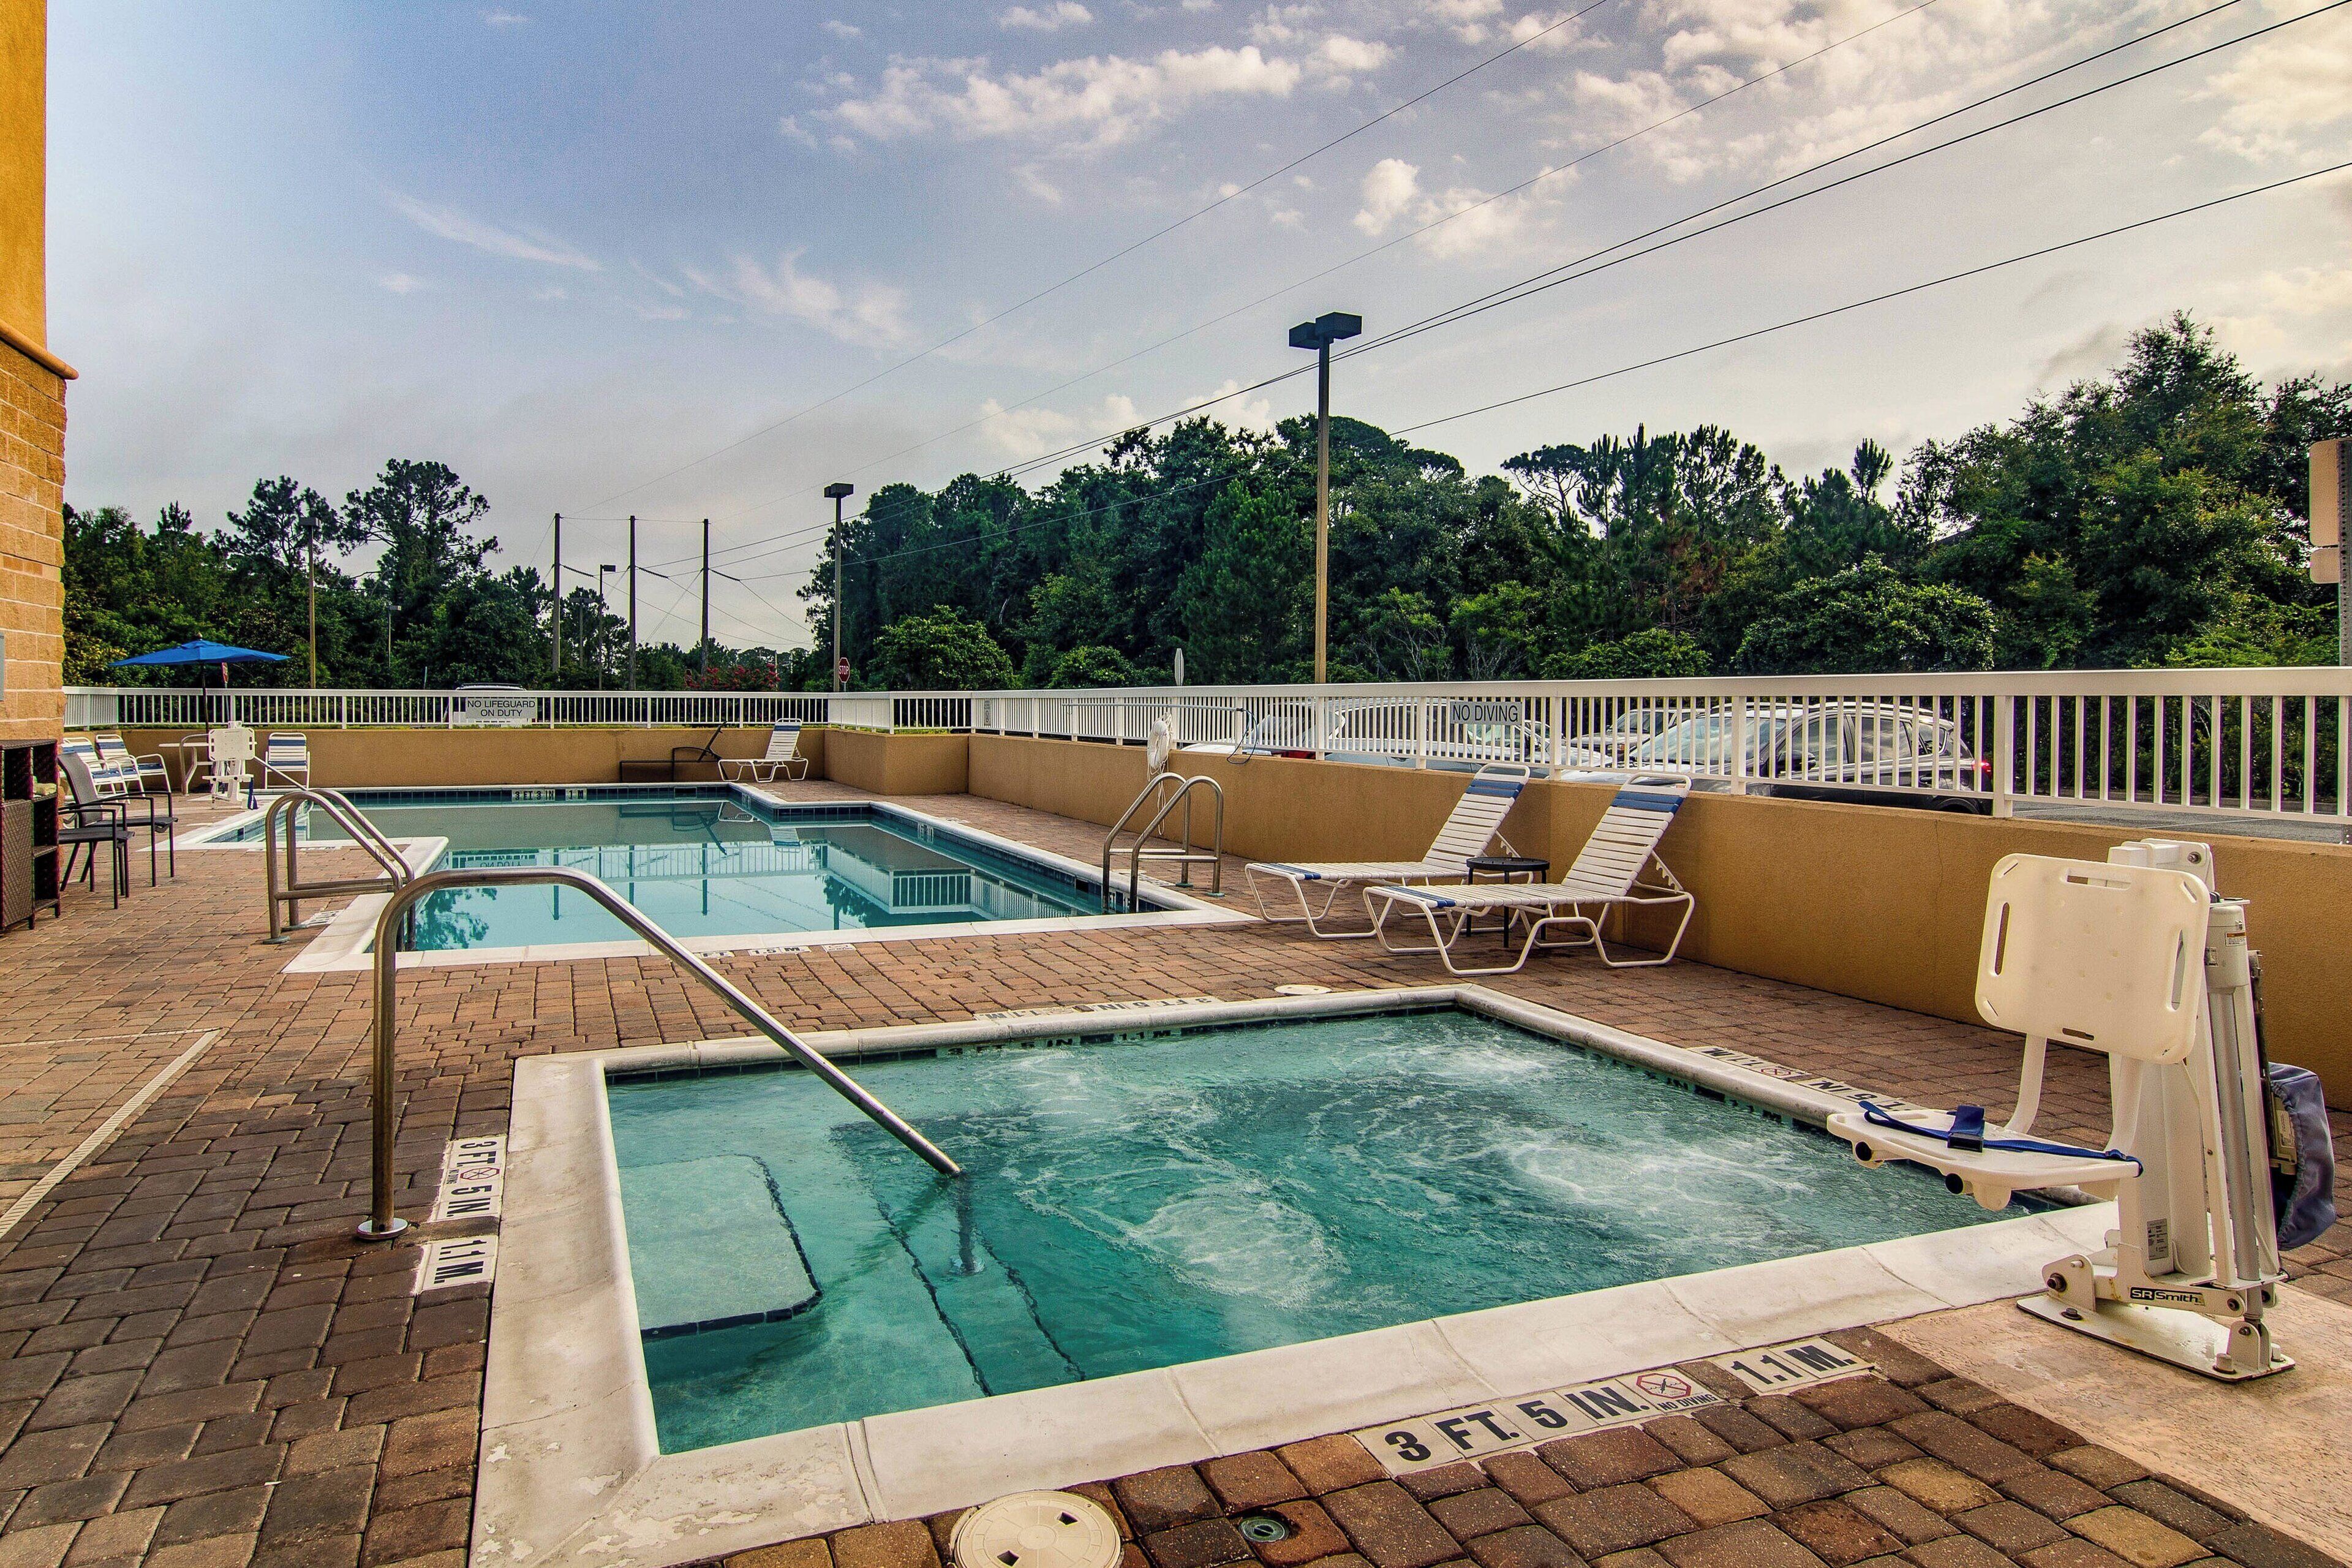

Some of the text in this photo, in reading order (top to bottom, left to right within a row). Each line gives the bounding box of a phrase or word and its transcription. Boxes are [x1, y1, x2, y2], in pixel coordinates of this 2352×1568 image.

[839, 665, 849, 675] STOP
[1453, 704, 1518, 722] NO DIVING
[456, 1151, 497, 1167] FT.
[447, 1185, 492, 1217] 5 IN.
[434, 1240, 487, 1284] 1.1 M.
[2155, 1292, 2198, 1303] Smith
[1731, 1345, 1858, 1385] 1.1 M.
[1656, 1393, 1719, 1411] NO DIVING
[1384, 1387, 1650, 1461] 3 FT. 5 IN.
